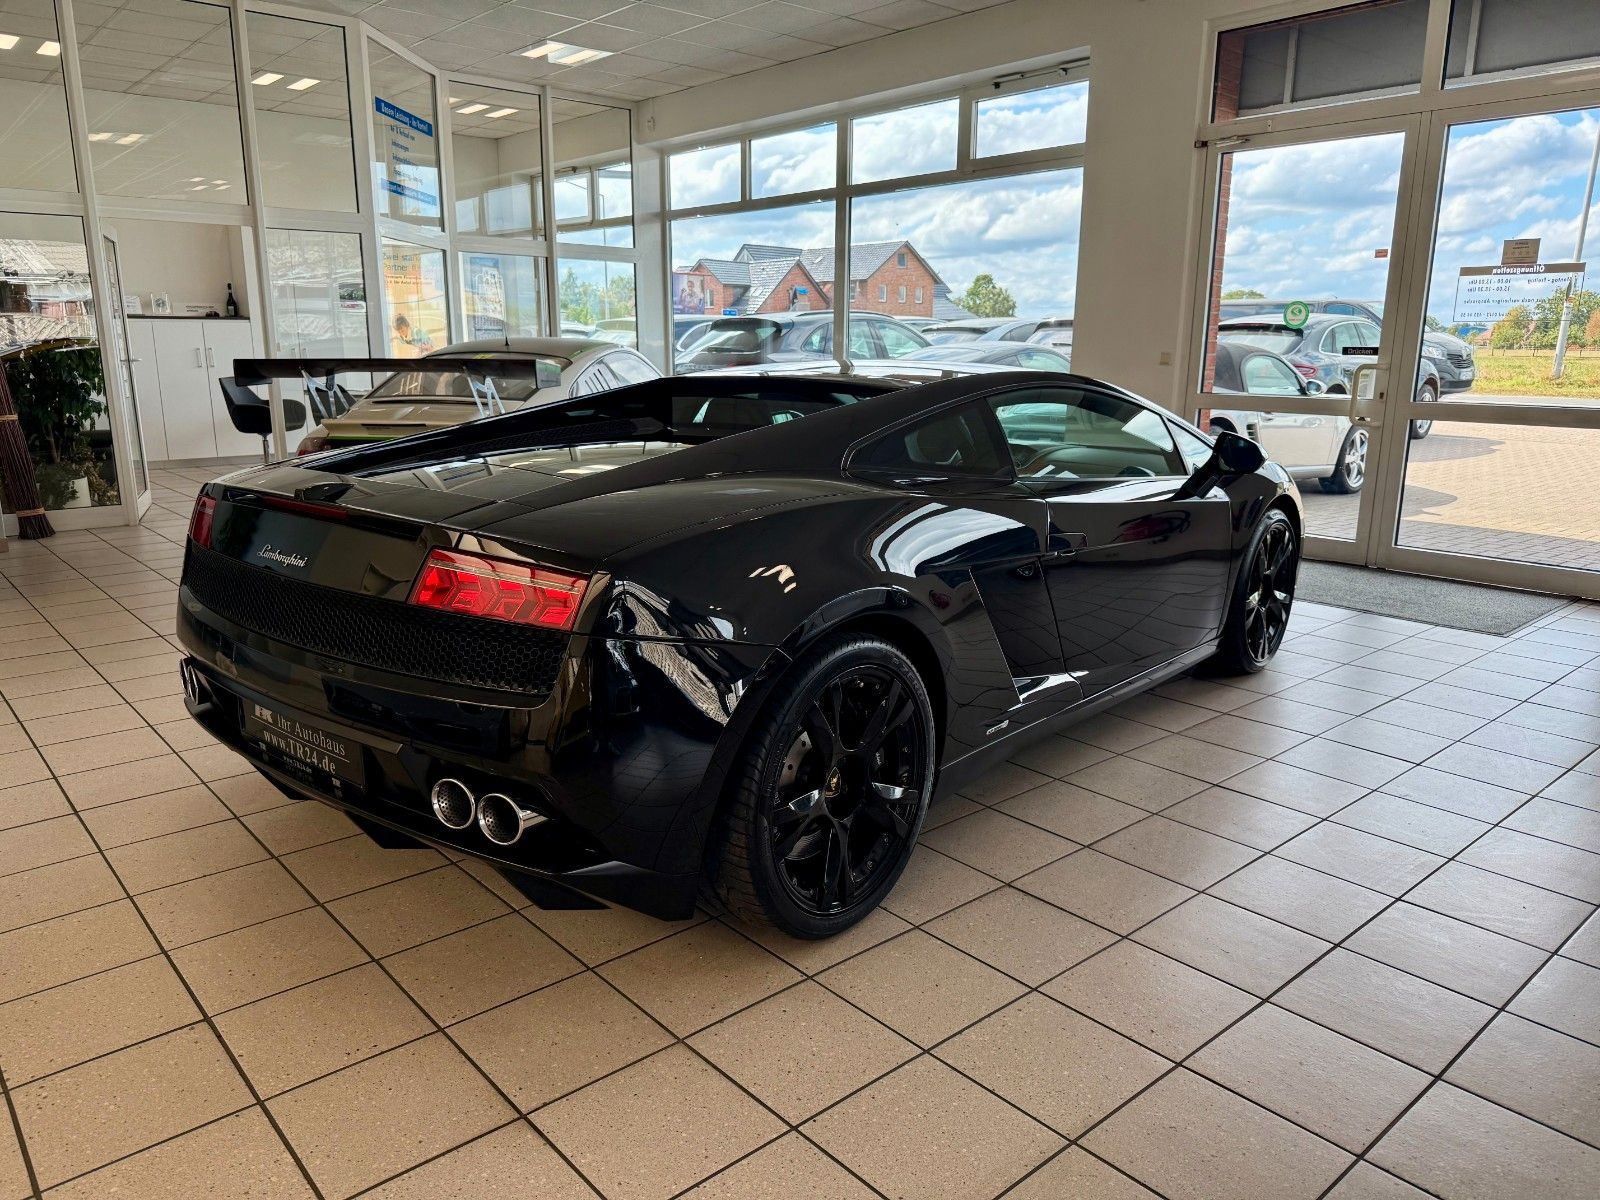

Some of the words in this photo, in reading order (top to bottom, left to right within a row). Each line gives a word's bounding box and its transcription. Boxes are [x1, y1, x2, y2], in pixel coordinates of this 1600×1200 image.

[256, 544, 308, 568] Lamborghini
[263, 730, 336, 775] www.TR24.de
[277, 713, 291, 732] Ihr
[294, 721, 346, 756] Autohaus
